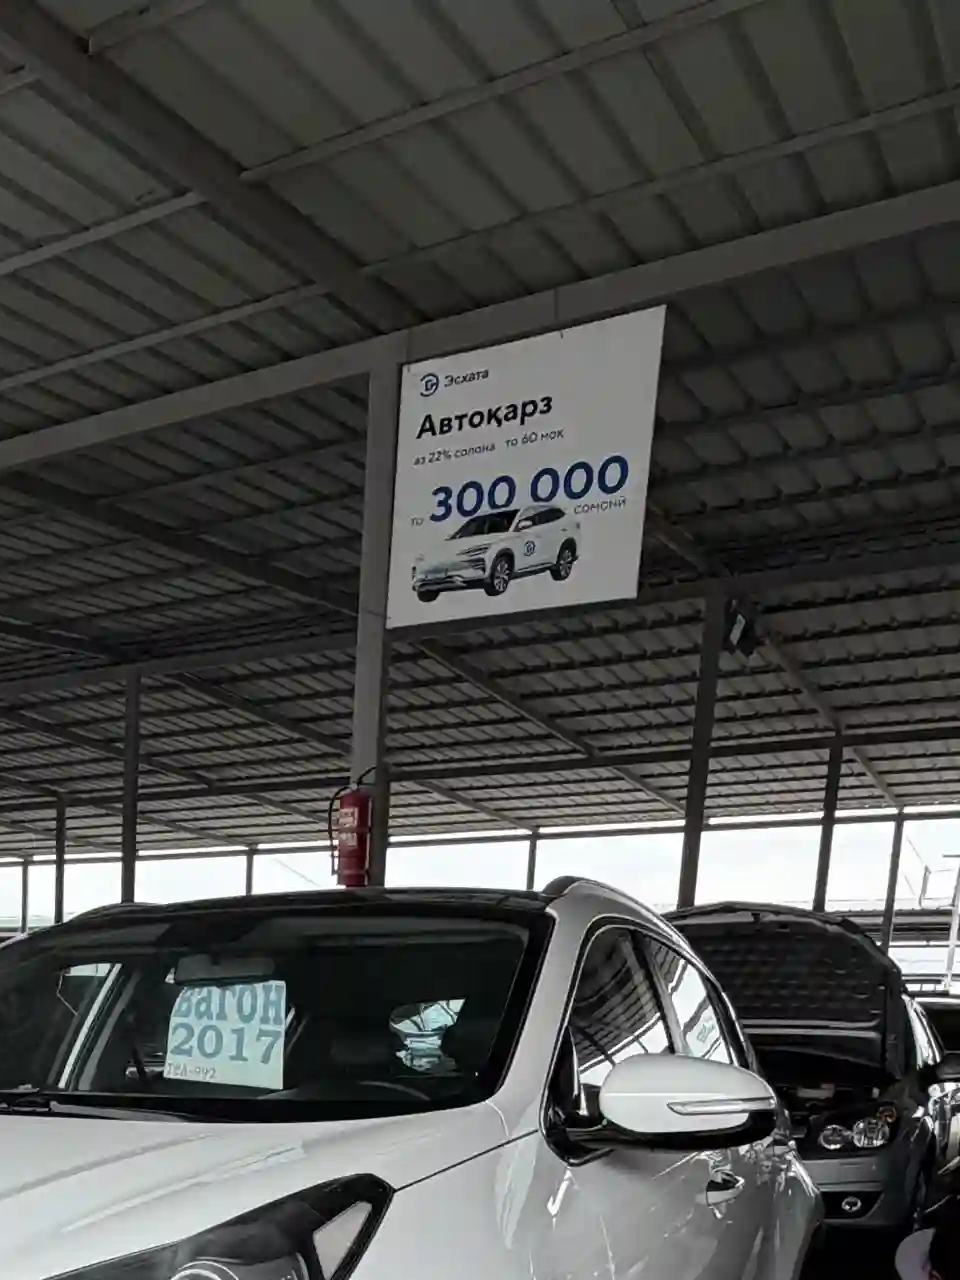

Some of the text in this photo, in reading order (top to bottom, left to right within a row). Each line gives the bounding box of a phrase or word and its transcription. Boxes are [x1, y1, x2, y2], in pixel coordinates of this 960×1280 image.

[443, 369, 489, 388] Эсхата
[428, 448, 452, 464] 22%
[522, 431, 538, 445] 60
[429, 475, 516, 523] 300
[530, 455, 629, 503] 000
[169, 1022, 282, 1065] 2017
